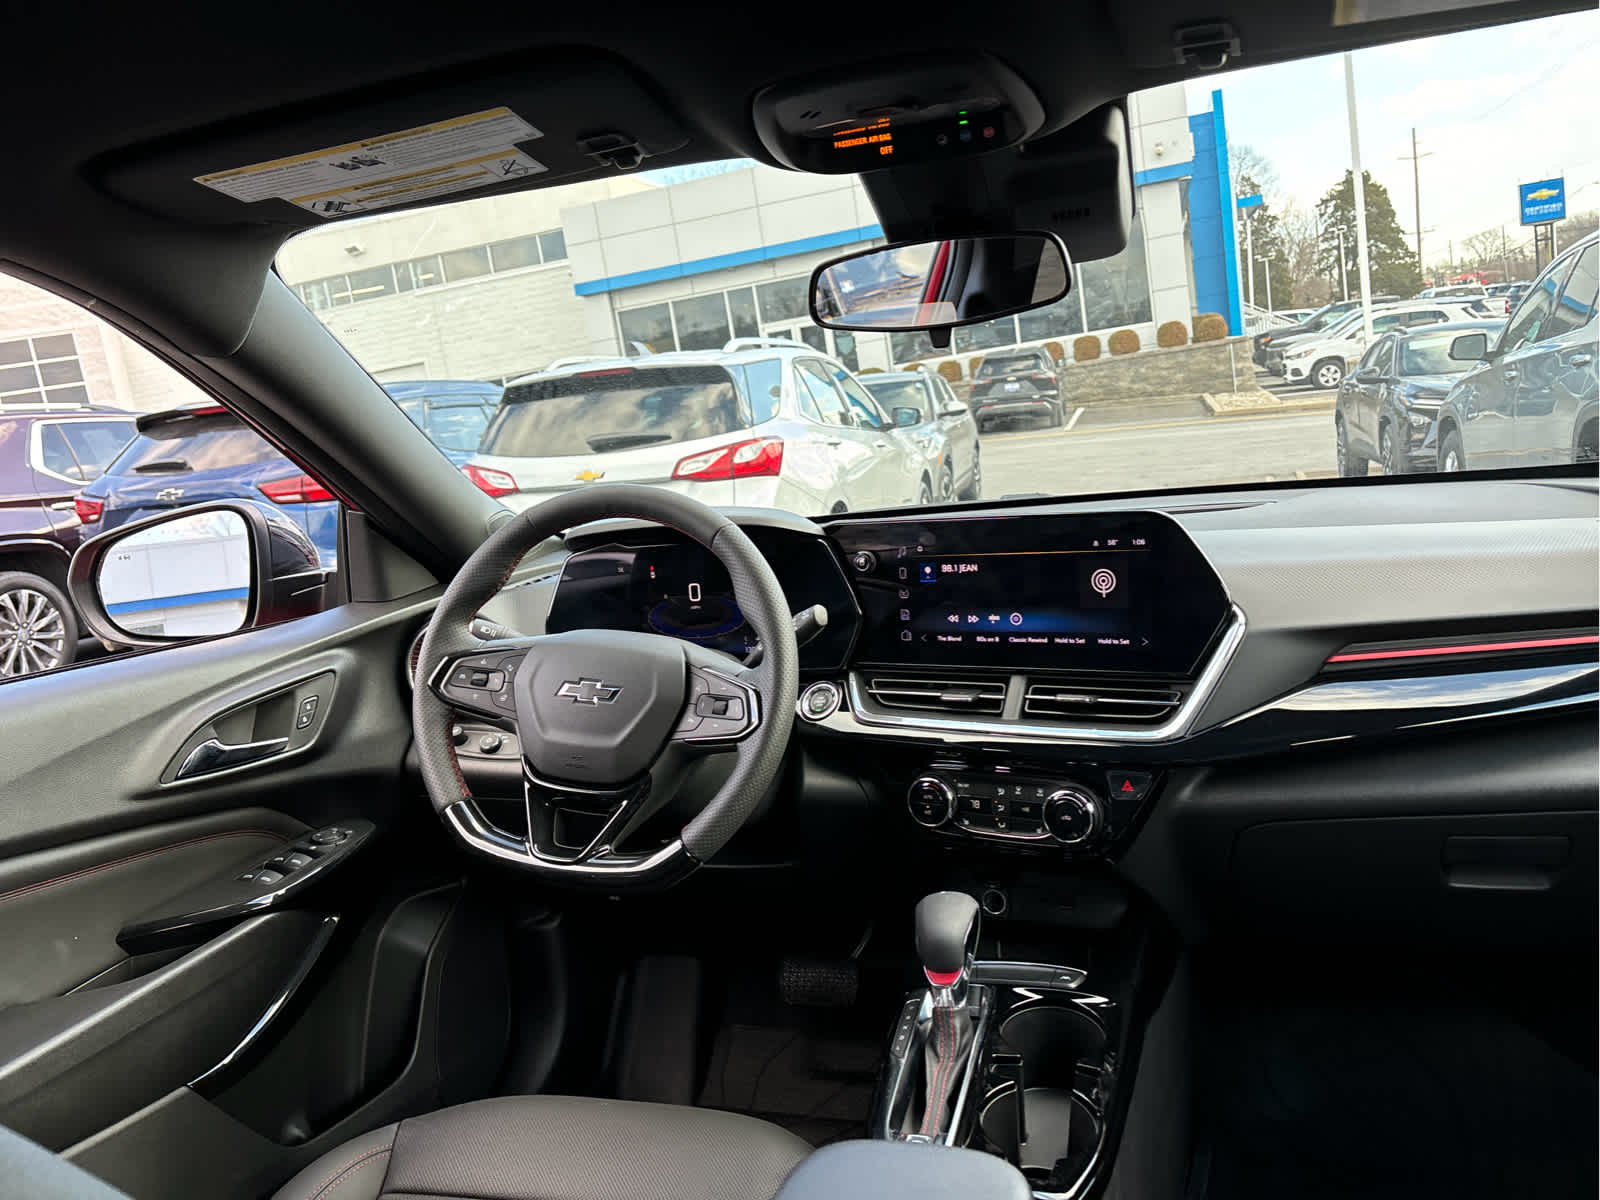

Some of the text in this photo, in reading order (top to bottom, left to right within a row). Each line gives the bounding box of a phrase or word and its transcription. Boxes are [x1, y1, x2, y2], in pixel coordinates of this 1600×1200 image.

[834, 137, 867, 149] PASSENGER
[879, 145, 893, 155] OFF
[941, 563, 978, 574] 98.1 JEAN
[1097, 637, 1111, 645] Hold
